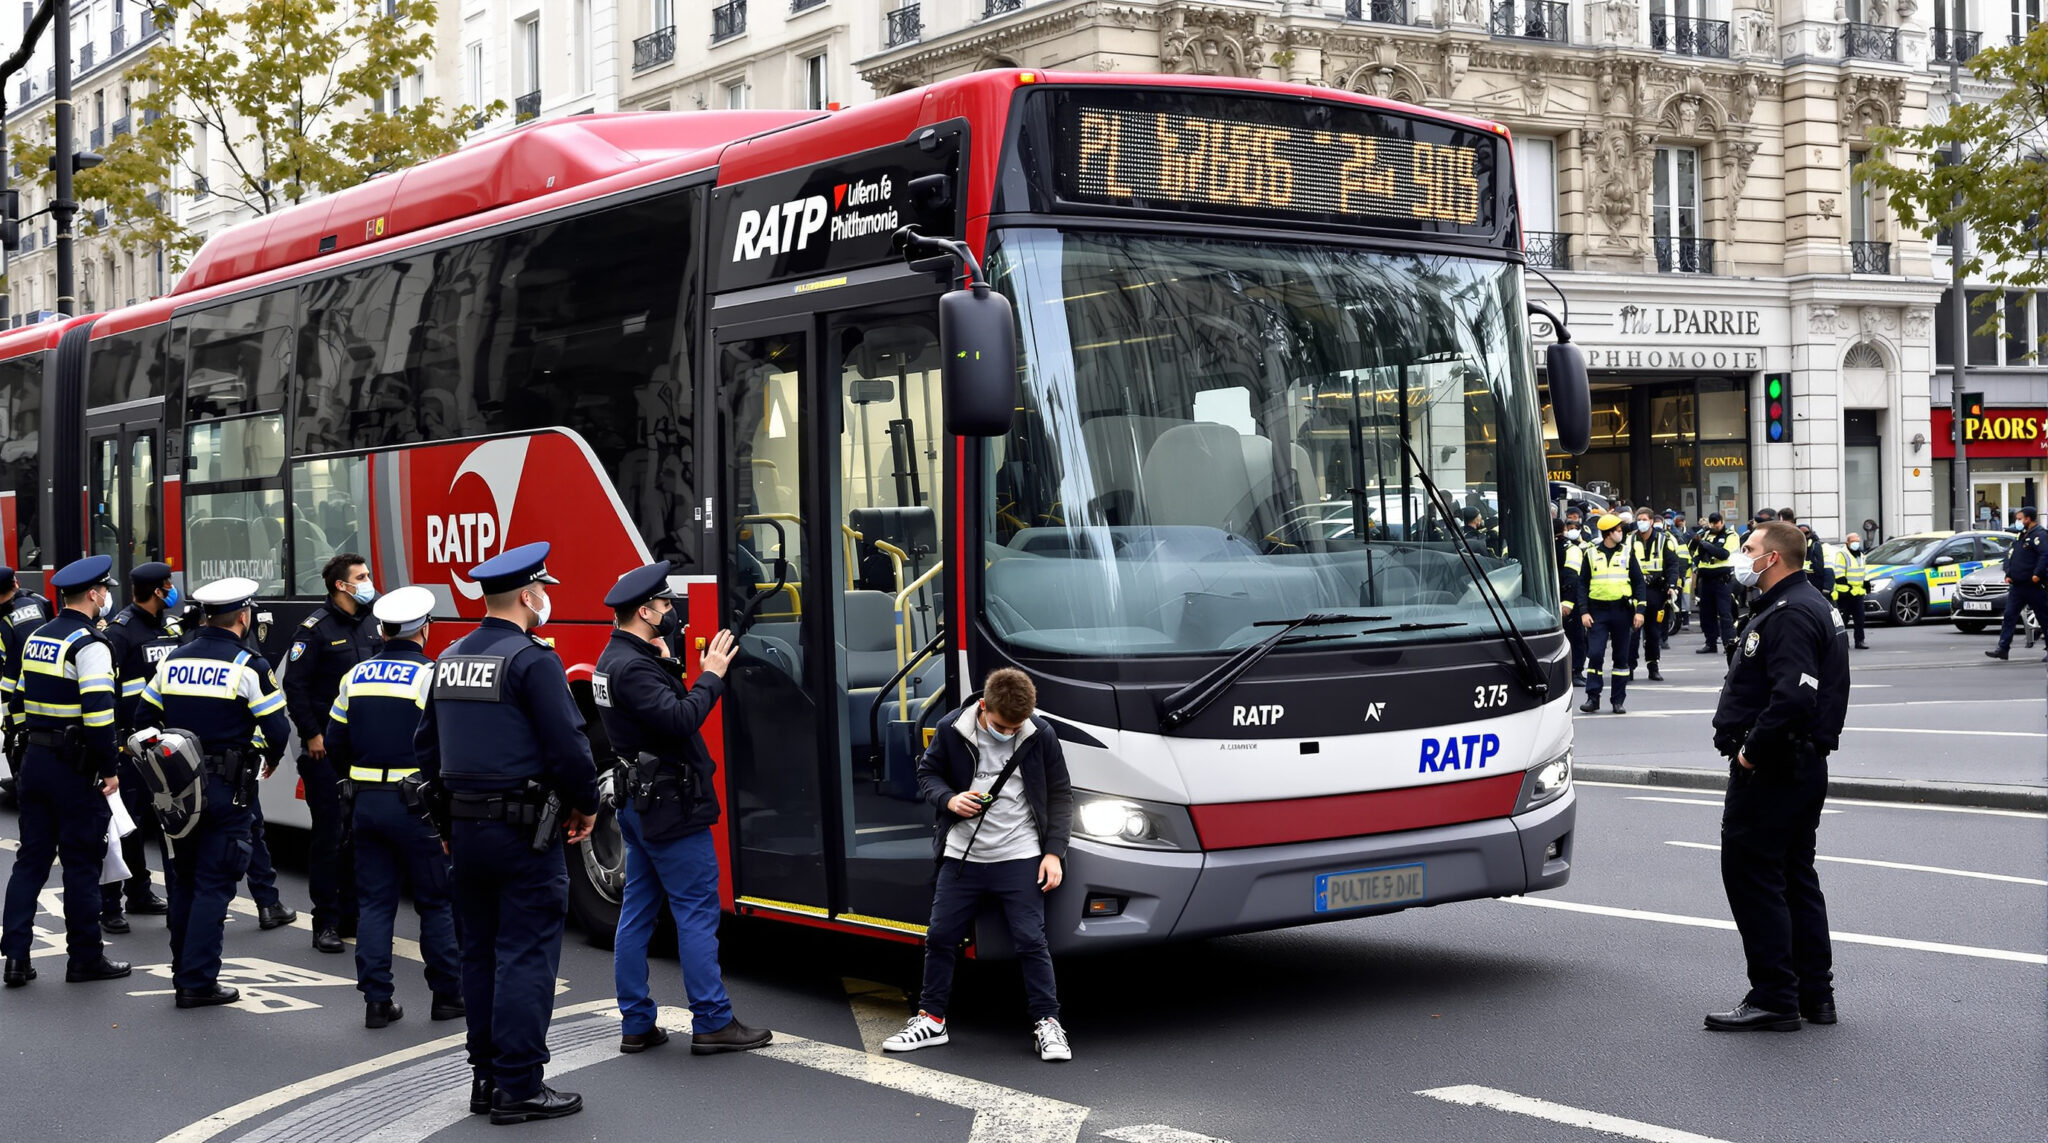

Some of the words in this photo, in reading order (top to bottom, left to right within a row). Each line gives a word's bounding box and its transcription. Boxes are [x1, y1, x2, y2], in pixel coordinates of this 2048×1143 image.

[732, 195, 828, 263] RATP
[1966, 417, 2038, 440] PAORS
[427, 512, 496, 564] RATP
[168, 666, 230, 686] POLICIE
[355, 663, 414, 682] POLICE
[437, 662, 497, 688] POLIZE
[1474, 685, 1509, 709] 3.75
[1232, 704, 1284, 726] RATP
[1418, 733, 1501, 773] RATP
